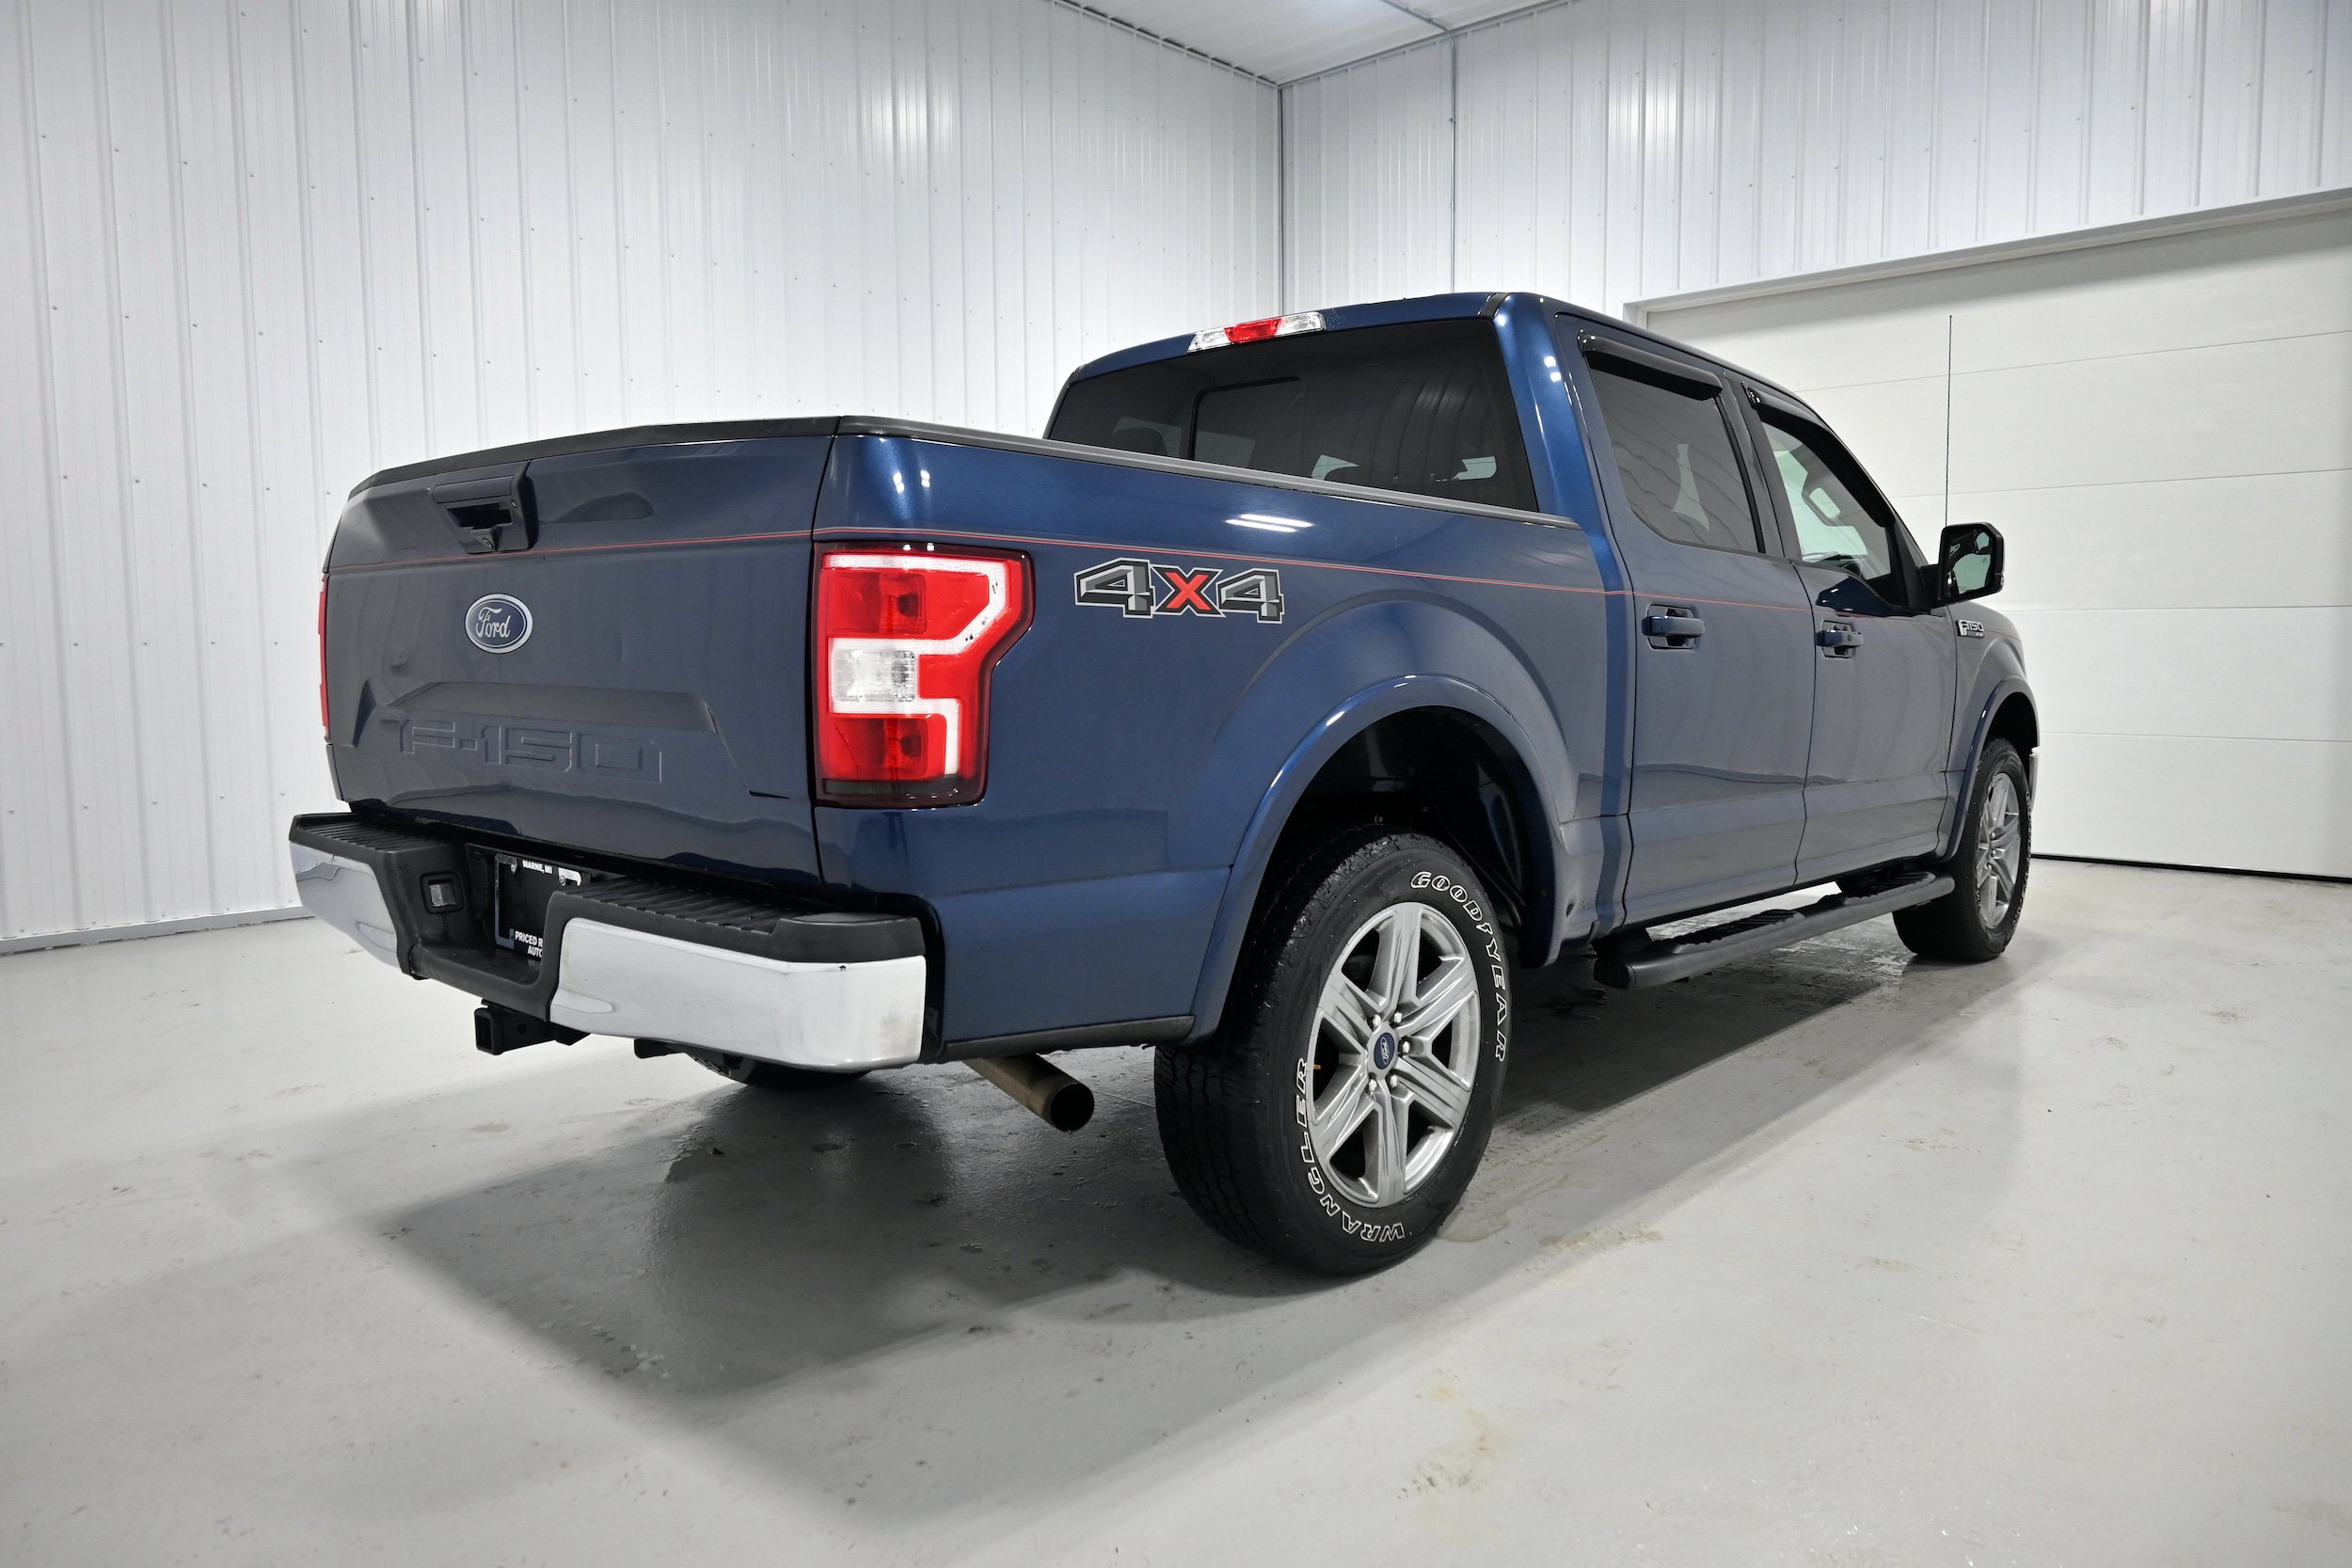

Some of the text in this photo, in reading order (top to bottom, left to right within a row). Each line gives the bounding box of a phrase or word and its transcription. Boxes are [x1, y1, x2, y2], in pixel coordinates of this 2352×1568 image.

[476, 607, 511, 638] Ford
[401, 718, 661, 783] F-150
[515, 931, 537, 945] PRICED
[1411, 871, 1507, 1062] GOODYEAR
[1296, 1057, 1406, 1243] WRANGLER
